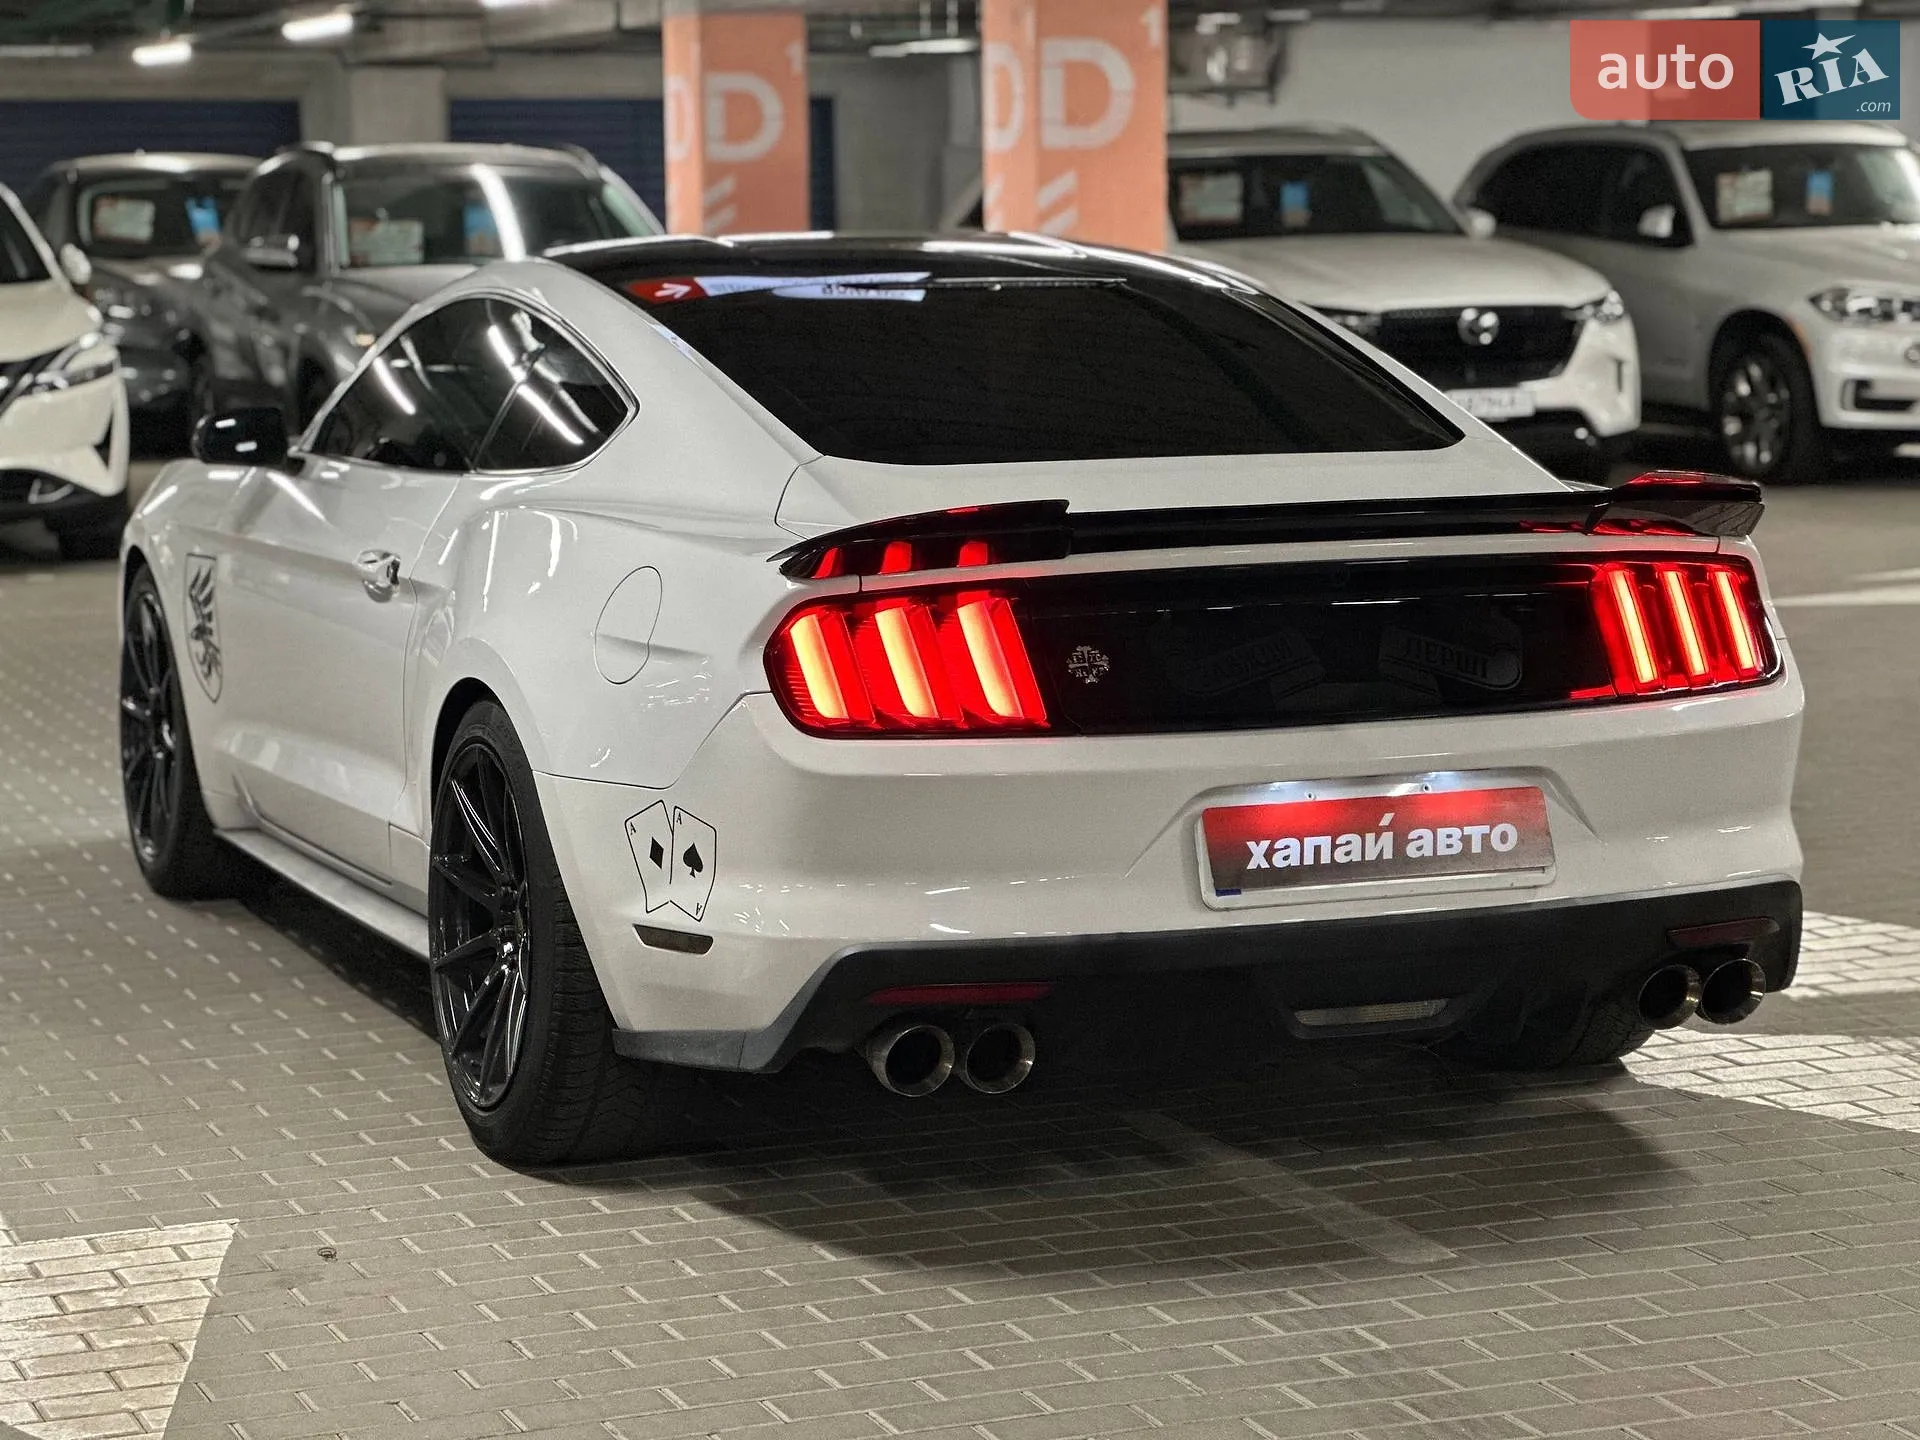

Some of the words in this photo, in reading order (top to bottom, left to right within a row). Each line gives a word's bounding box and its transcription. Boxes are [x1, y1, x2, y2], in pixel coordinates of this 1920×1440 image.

[1041, 36, 1136, 151] D
[1141, 5, 1163, 47] 1
[706, 71, 784, 162] D
[629, 822, 637, 836] A
[675, 812, 683, 825] A
[1405, 822, 1519, 859] авто
